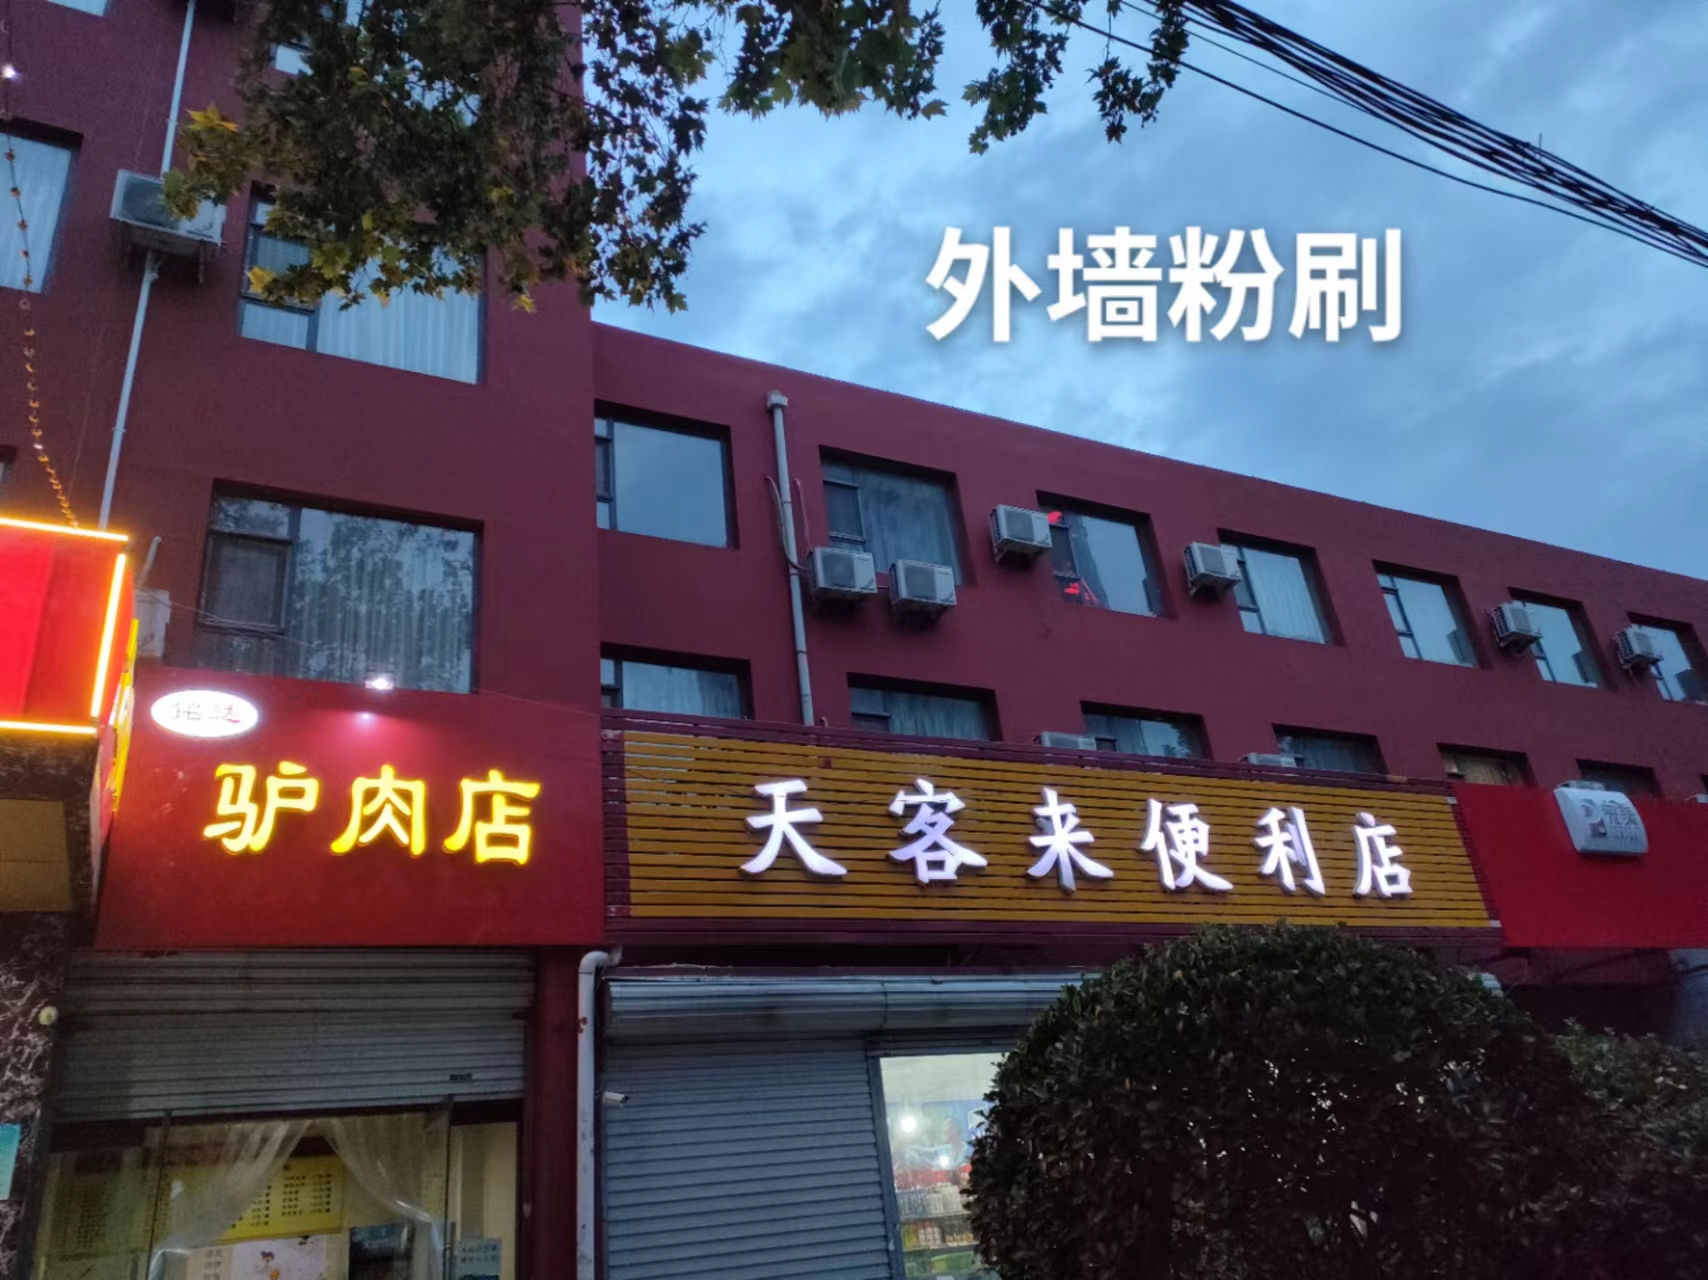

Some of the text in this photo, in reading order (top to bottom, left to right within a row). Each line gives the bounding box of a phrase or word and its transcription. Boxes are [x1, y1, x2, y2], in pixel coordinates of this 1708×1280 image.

[203, 760, 542, 865] 驴肉店
[739, 777, 1414, 899] 天客来便利店
